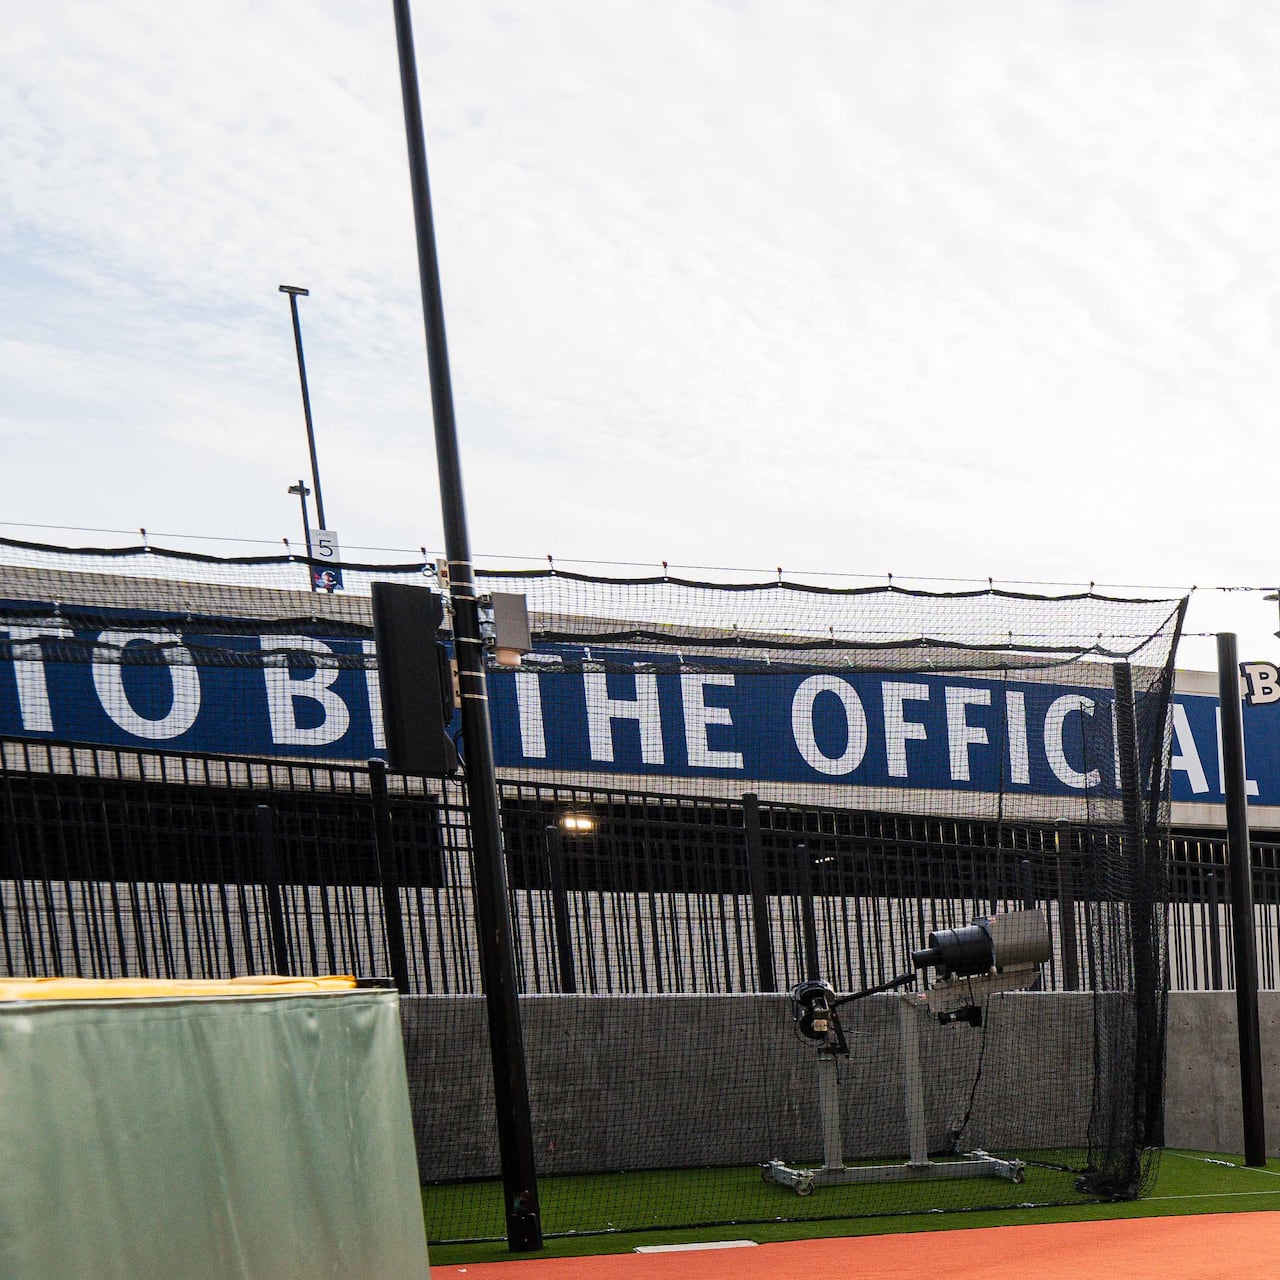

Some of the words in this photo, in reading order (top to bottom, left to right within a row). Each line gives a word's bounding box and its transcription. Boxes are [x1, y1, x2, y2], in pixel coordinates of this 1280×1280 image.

[319, 539, 334, 557] 5
[0, 617, 201, 740] TO
[259, 634, 388, 750] B
[490, 653, 745, 769] THE
